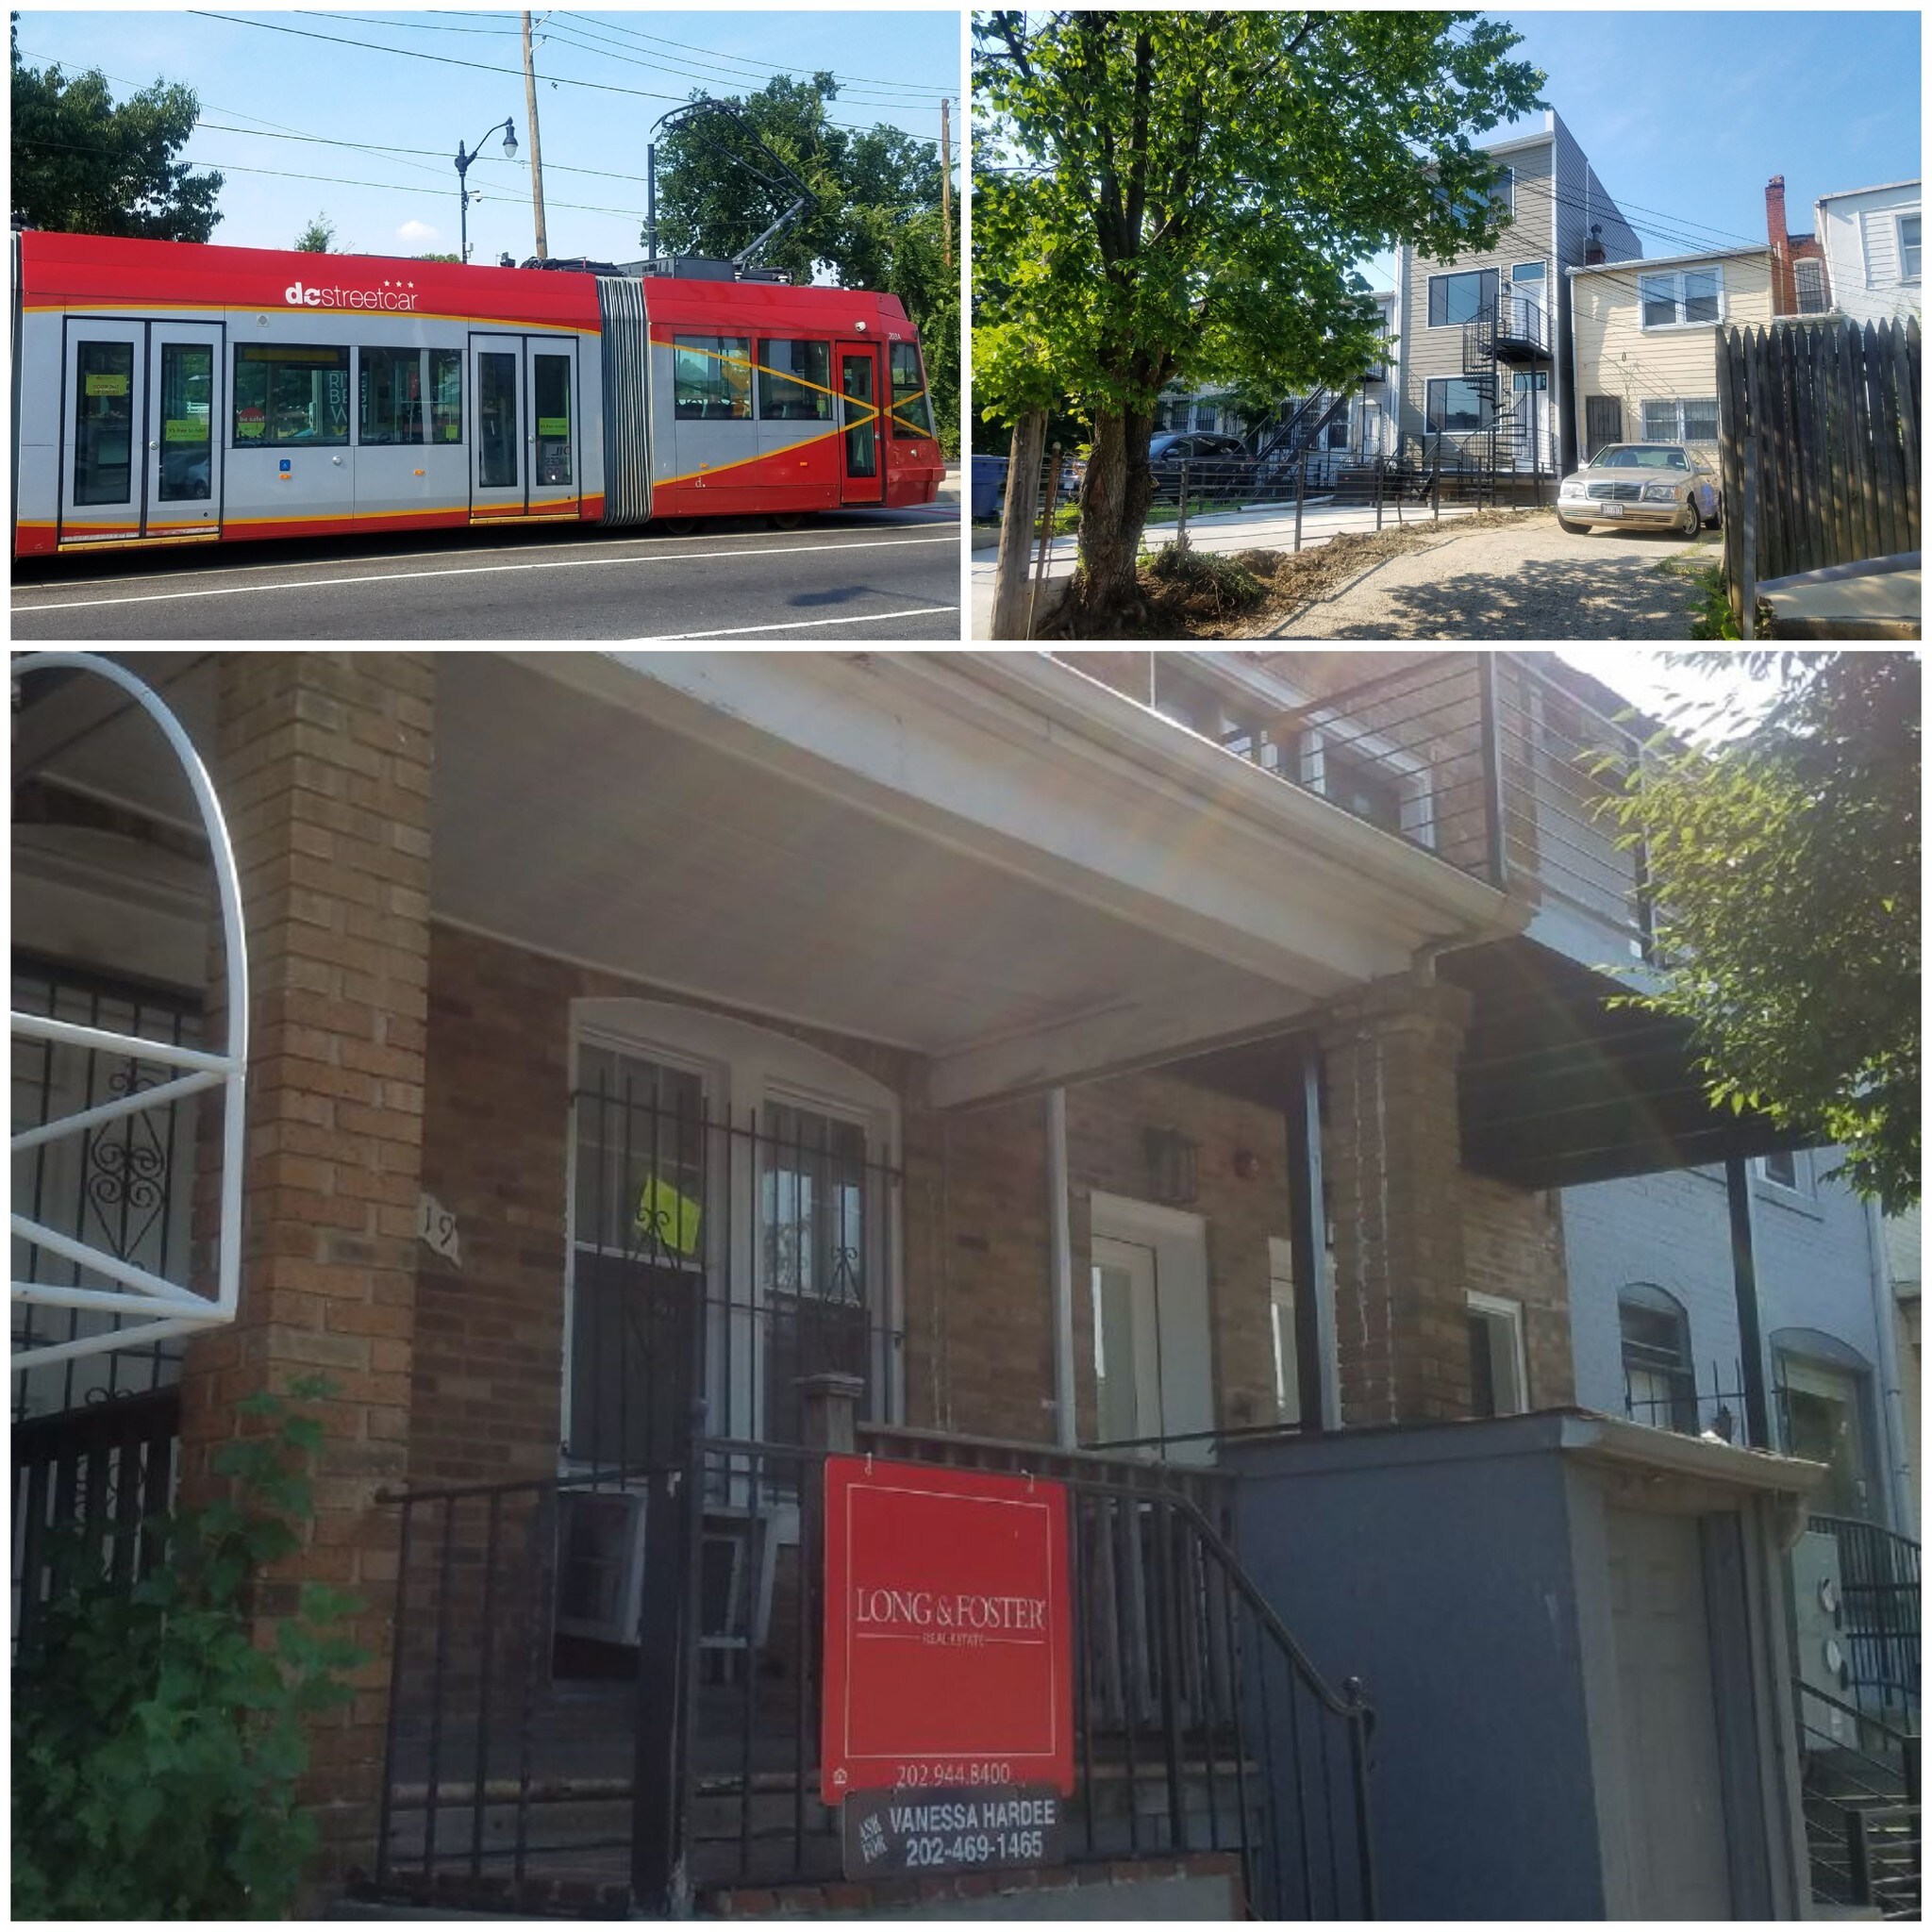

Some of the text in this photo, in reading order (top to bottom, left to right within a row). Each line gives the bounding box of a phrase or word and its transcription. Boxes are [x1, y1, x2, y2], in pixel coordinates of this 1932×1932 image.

[857, 1589, 1046, 1630] LONG & FOSTER
[923, 1632, 985, 1647] REAL ESTATE
[896, 1763, 1010, 1789] 202.944.8400
[858, 1813, 882, 1842] ASK
[890, 1799, 1056, 1834] VANESSA HARDEE
[906, 1830, 1043, 1867] 202-469-1465
